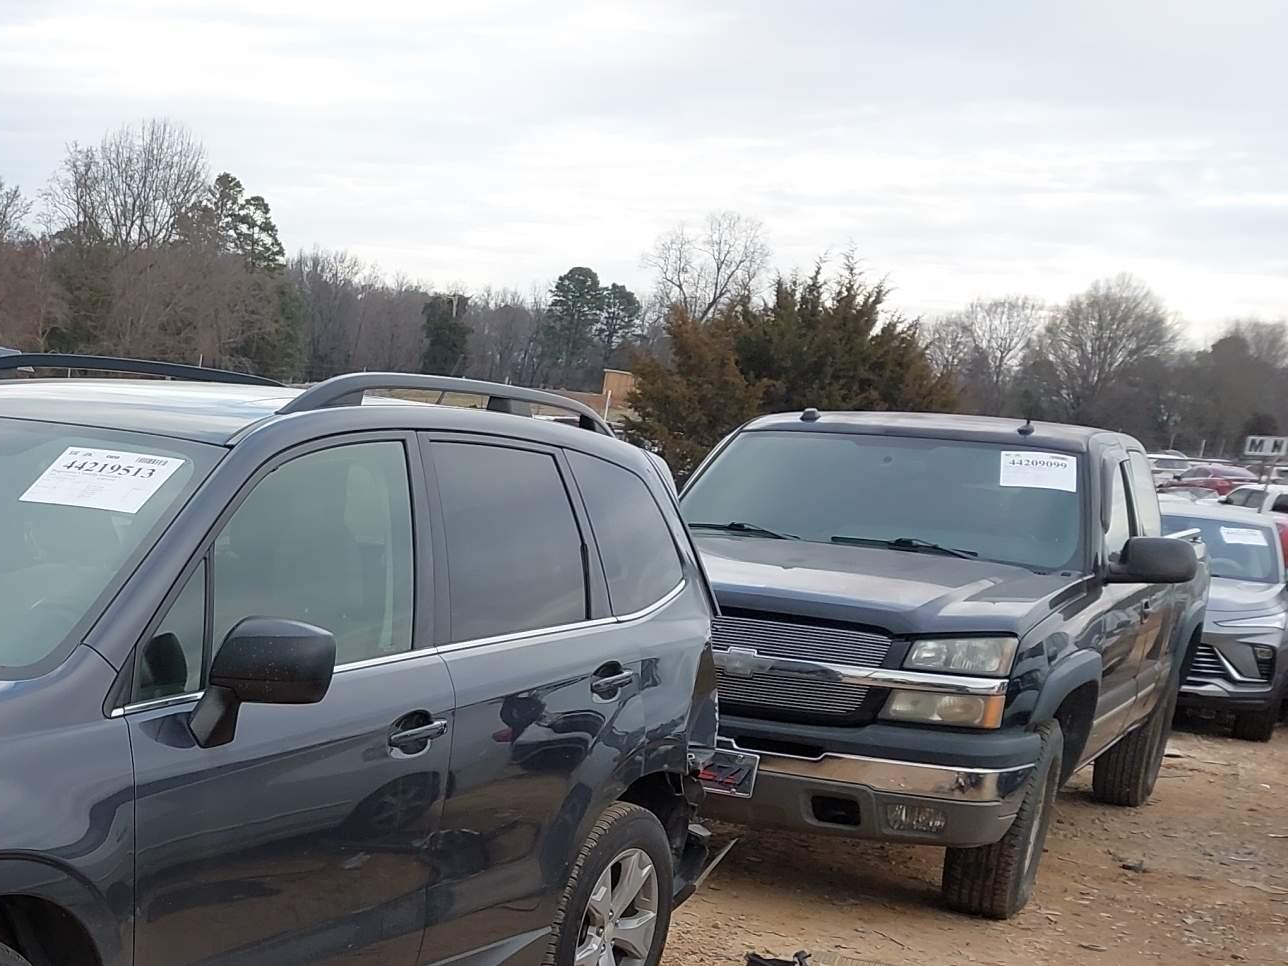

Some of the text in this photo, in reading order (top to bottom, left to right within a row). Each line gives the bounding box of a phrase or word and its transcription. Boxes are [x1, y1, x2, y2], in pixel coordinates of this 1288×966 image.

[1248, 438, 1265, 453] M
[64, 459, 156, 479] 44219513
[1009, 458, 1068, 470] 44209099
